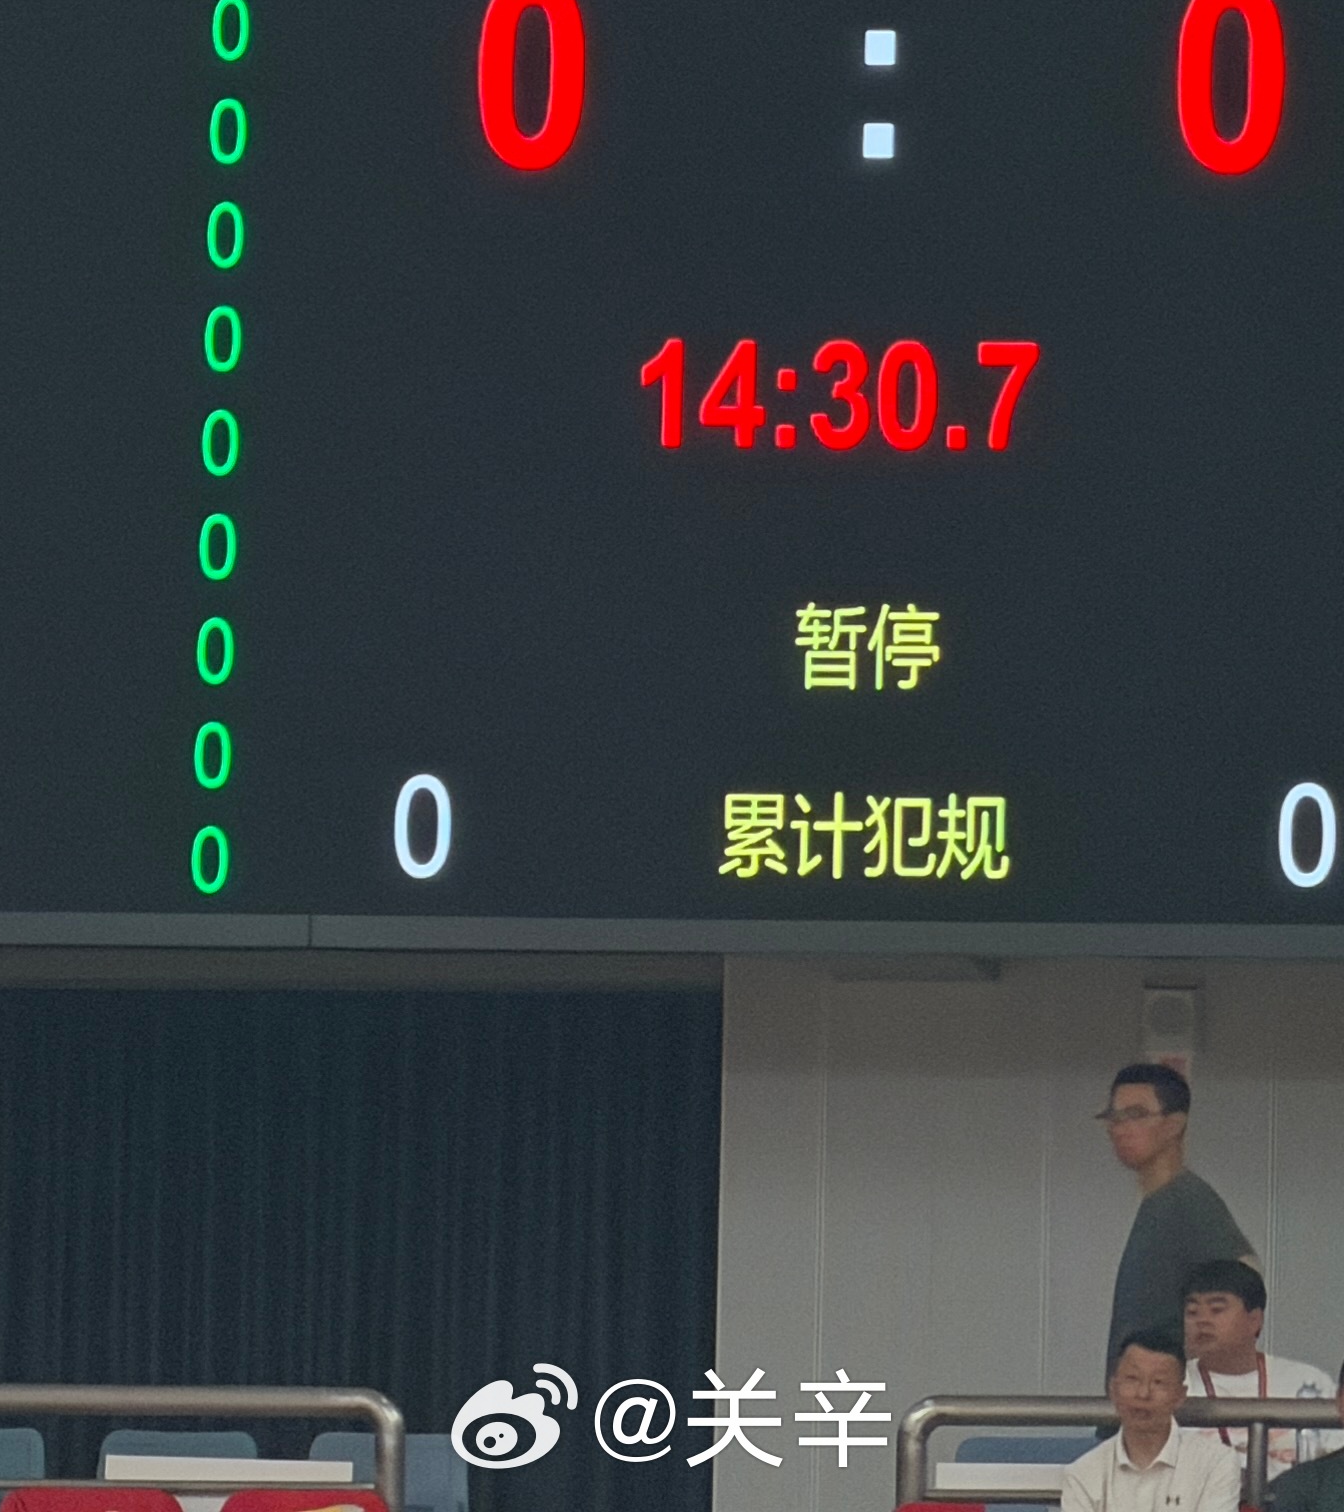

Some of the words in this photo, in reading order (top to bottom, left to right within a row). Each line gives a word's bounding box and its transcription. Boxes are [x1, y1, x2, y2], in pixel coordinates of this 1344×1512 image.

[210, 98, 247, 164] 0
[207, 201, 244, 269] 0
[204, 306, 241, 372] 0
[641, 338, 1040, 452] 14:30.7
[202, 409, 239, 476] 0
[199, 514, 236, 580] 0
[197, 617, 234, 685] 0
[795, 602, 940, 690] 暂停
[194, 722, 231, 789] 0
[191, 826, 229, 894] 0
[394, 774, 452, 879] 0
[719, 792, 1010, 880] 累计犯规
[1279, 782, 1336, 887] 0
